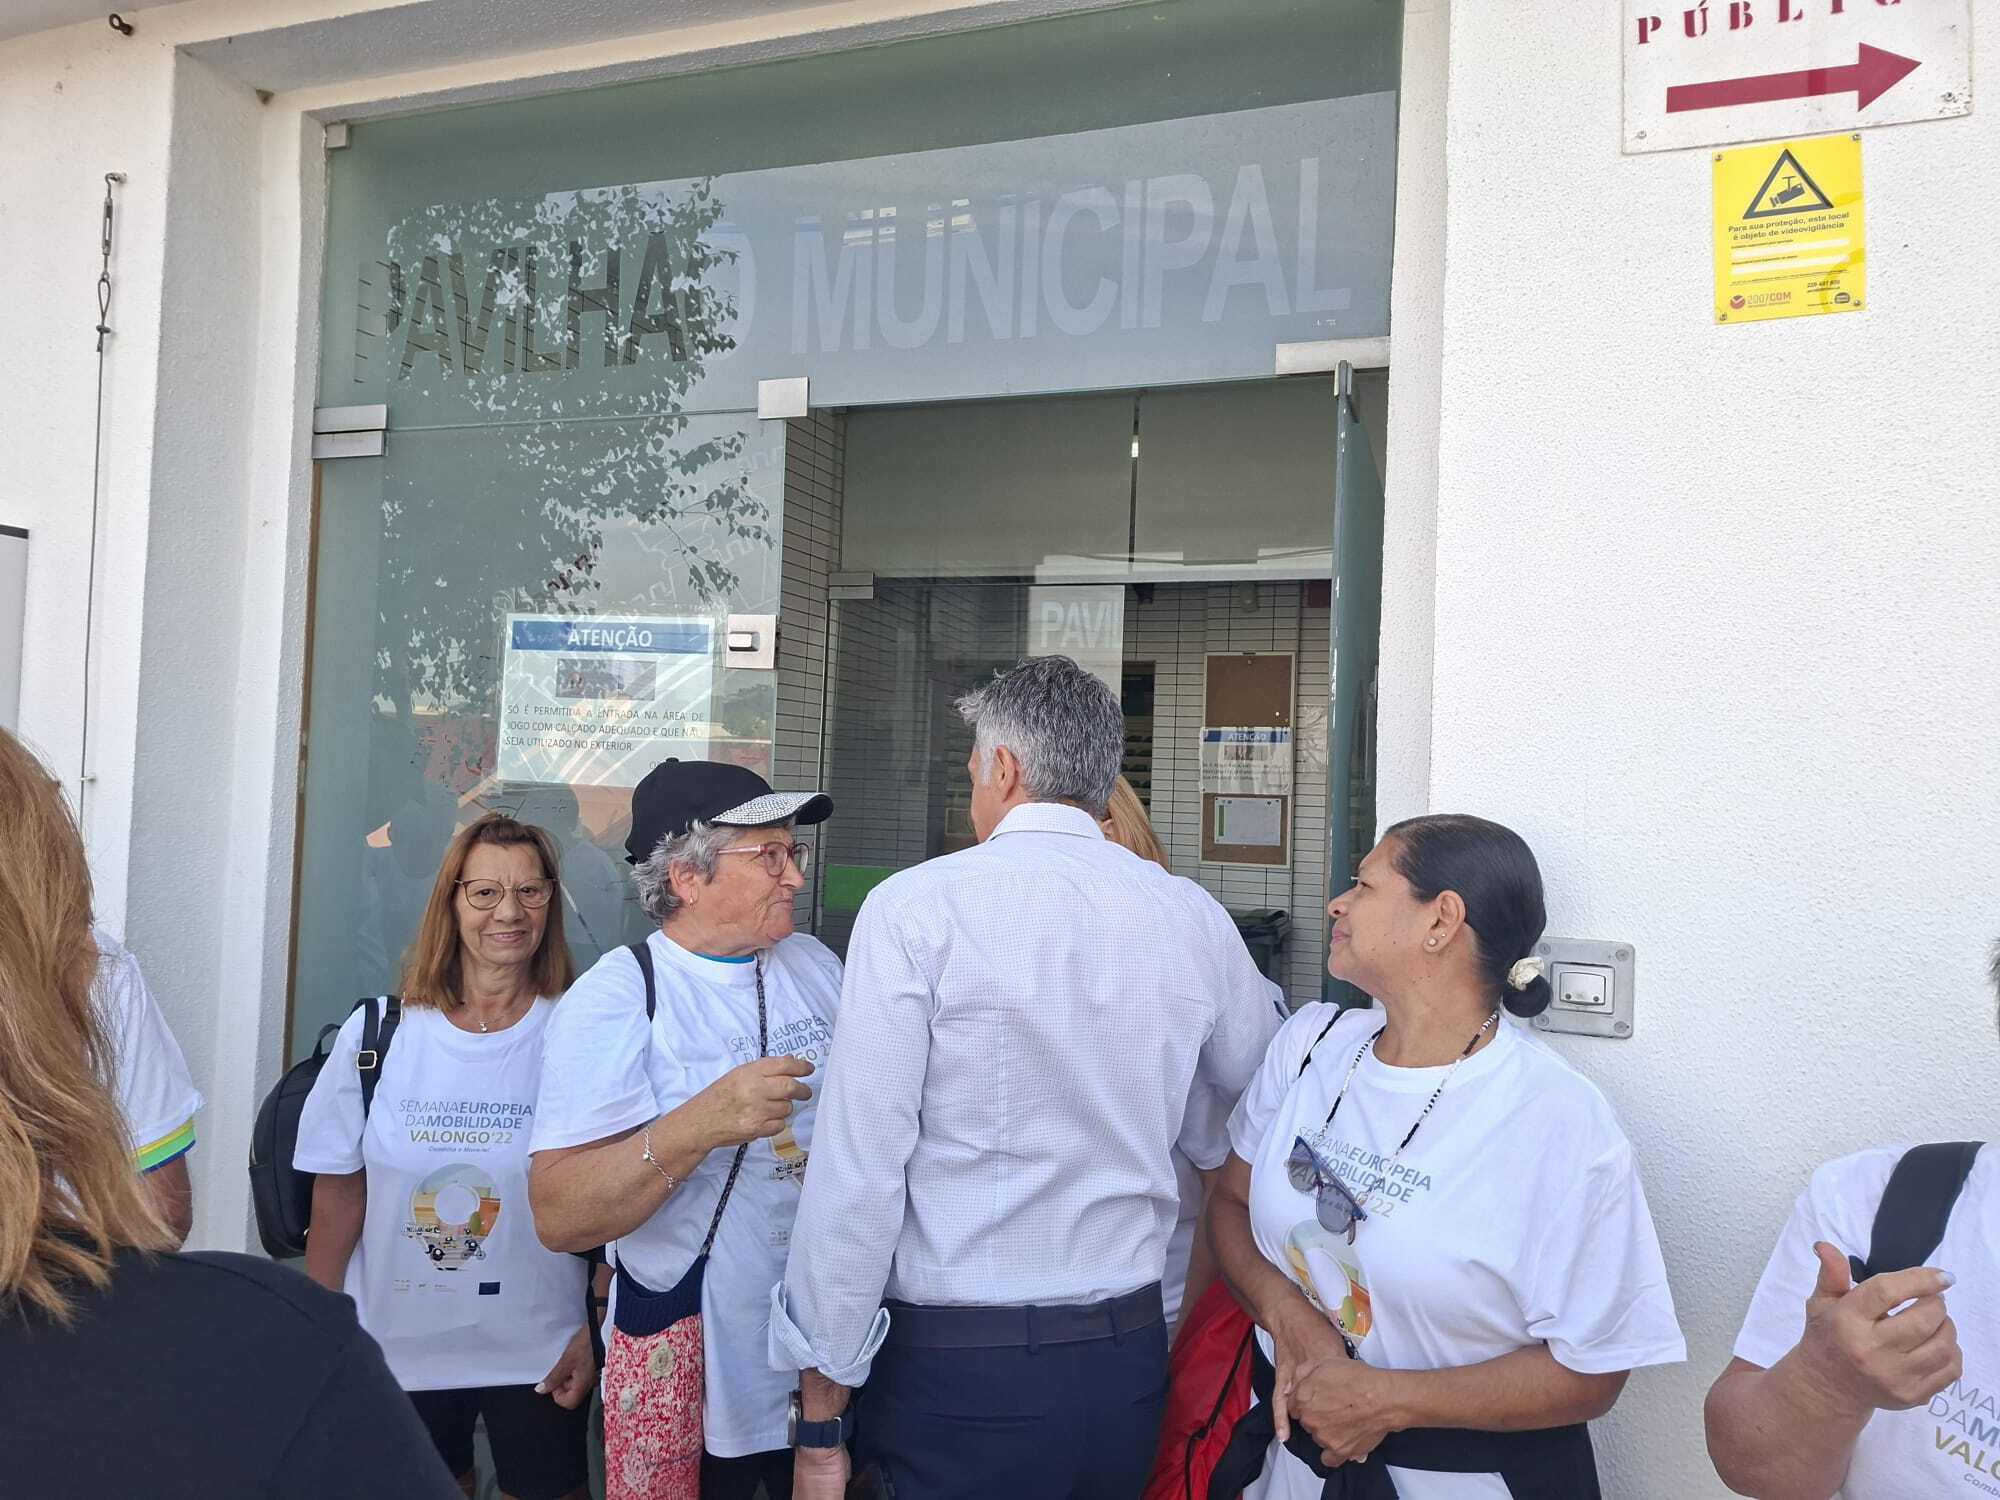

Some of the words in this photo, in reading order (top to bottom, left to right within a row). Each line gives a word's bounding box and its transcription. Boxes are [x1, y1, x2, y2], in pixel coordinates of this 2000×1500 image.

[1728, 223, 1747, 233] Para
[1828, 212, 1849, 221] local
[1768, 229, 1780, 237] de
[790, 157, 1351, 355] MUNICIPAL
[567, 626, 653, 651] ATENÇÃO
[508, 704, 519, 714] SÓ
[524, 703, 529, 714] É
[534, 705, 581, 717] PERMITIDA
[598, 709, 639, 720] ENTRADA
[644, 710, 658, 720] NA
[691, 711, 704, 722] DE
[532, 722, 553, 732] COM
[555, 723, 596, 735] CALÇADO
[599, 725, 651, 737] ADEQUADO
[660, 727, 679, 738] QUE
[527, 738, 571, 748] UTILIZADO
[574, 739, 588, 749] NO
[399, 1099, 533, 1116] SEMANAEUROPEIA
[404, 1114, 522, 1129] DAMOBILIDADE
[1928, 1394, 2000, 1447] DAM
